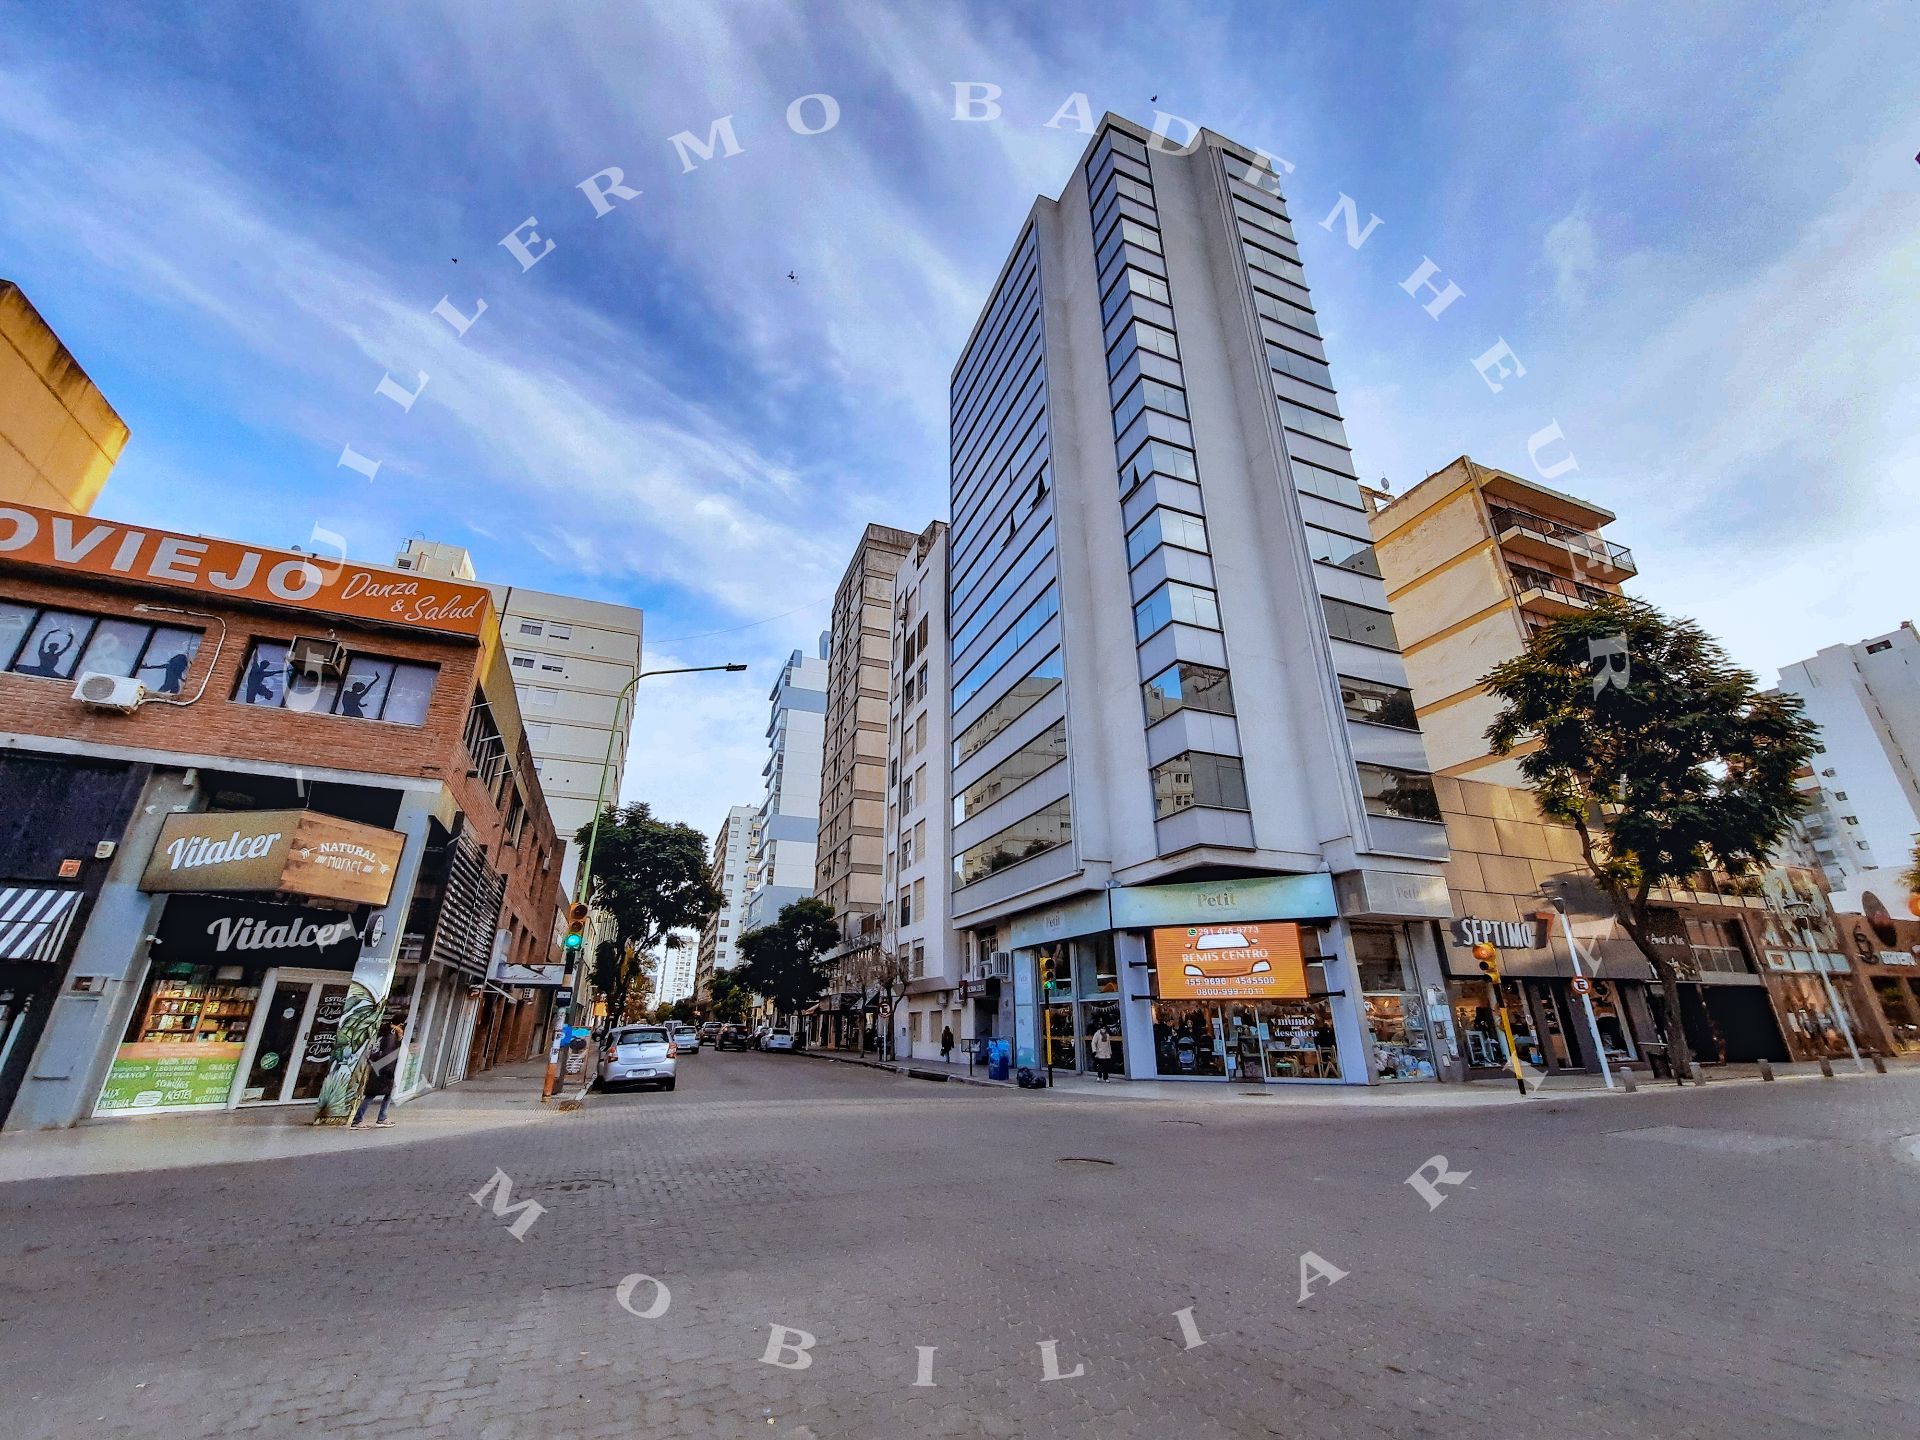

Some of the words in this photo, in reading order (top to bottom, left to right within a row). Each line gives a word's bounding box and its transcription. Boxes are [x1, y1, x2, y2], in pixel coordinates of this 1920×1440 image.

[341, 572, 419, 600] Danza
[390, 599, 404, 613] &
[404, 595, 487, 622] Salud
[167, 831, 282, 870] Vitalcer
[320, 842, 376, 863] NATURAL
[1198, 893, 1236, 907] Petit
[207, 917, 350, 951] Vitalcer
[1181, 951, 1219, 963] REMIS
[1221, 948, 1269, 961] CENTRO
[1278, 1016, 1315, 1026] mundo
[1274, 1029, 1320, 1038] descubrir
